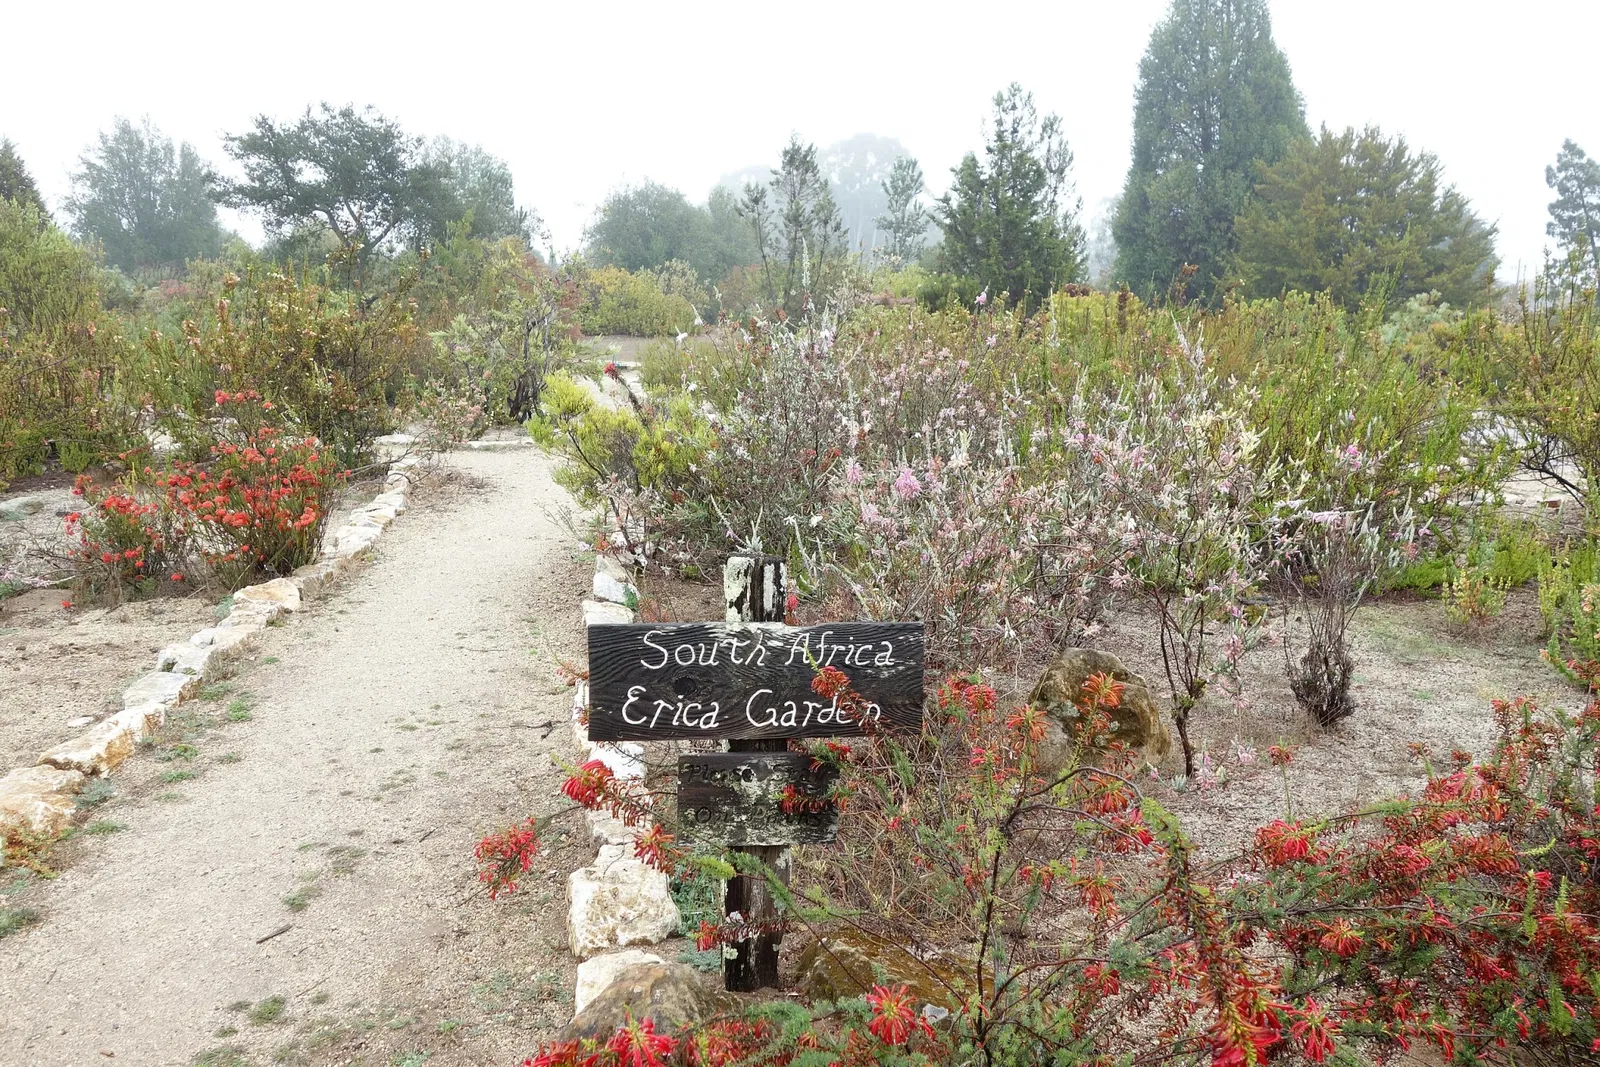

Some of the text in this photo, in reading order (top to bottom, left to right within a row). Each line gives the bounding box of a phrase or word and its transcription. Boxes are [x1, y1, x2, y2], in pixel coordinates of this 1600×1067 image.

[640, 629, 895, 669] South Africa
[621, 685, 882, 729] Erica Garden
